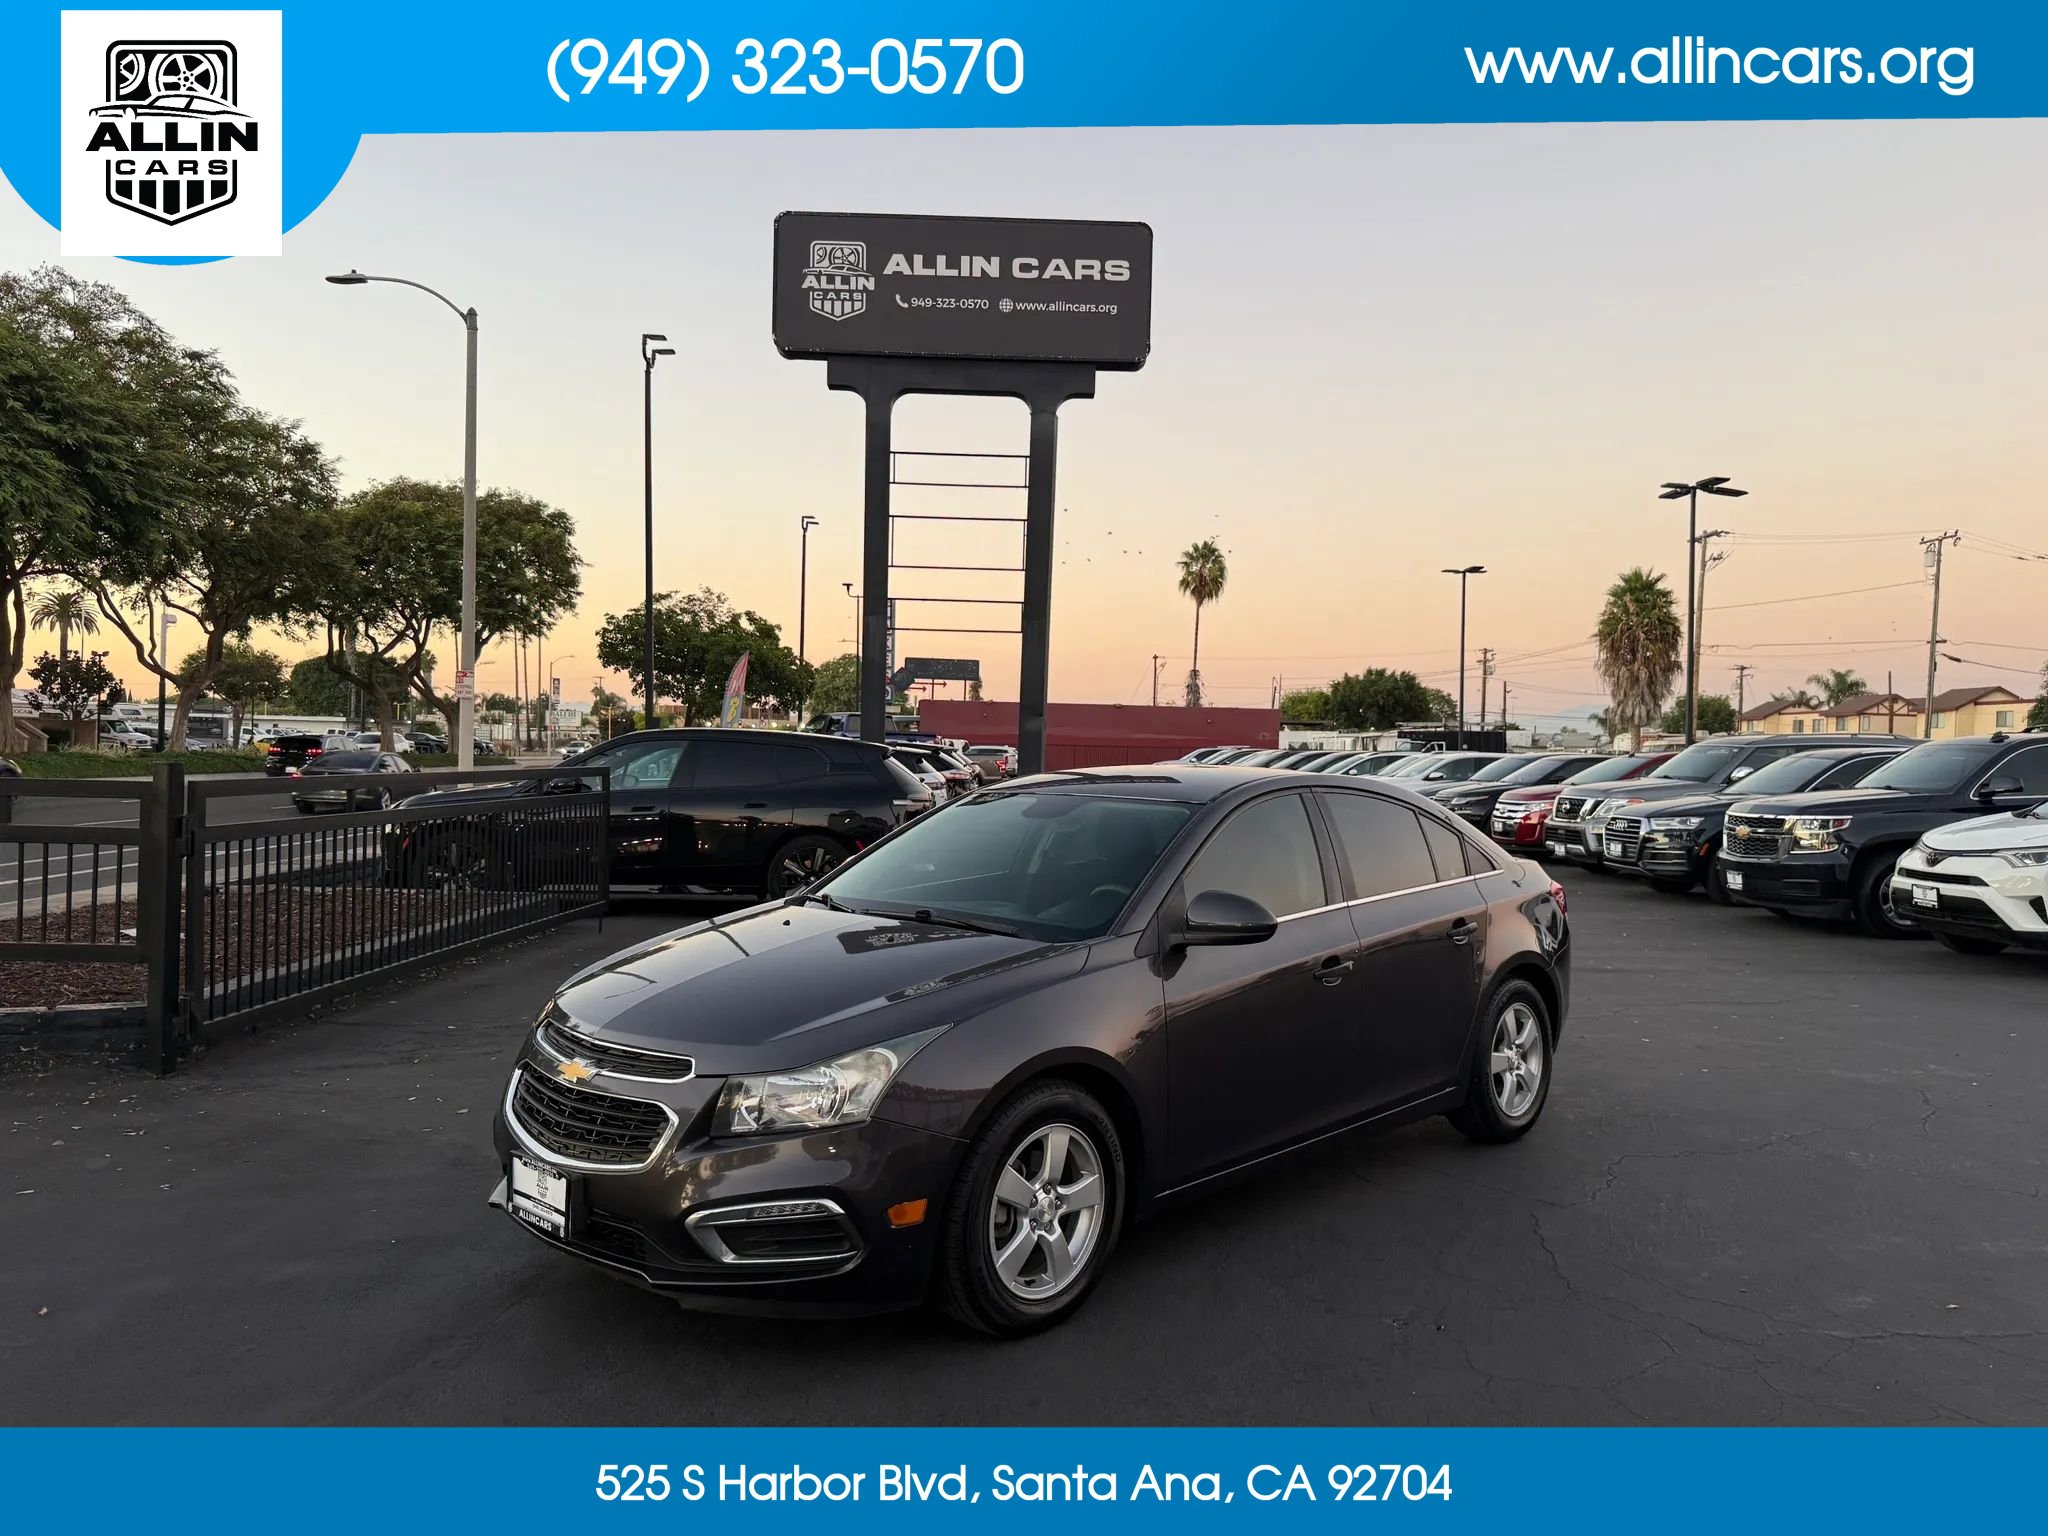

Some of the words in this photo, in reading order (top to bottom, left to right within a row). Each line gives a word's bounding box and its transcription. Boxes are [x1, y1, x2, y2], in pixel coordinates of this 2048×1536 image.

[883, 253, 1000, 278] ALLIN
[1012, 258, 1131, 282] CARS
[802, 273, 875, 291] ALLIN
[813, 291, 862, 301] CARS
[911, 297, 989, 310] 949-323-0570
[1015, 300, 1118, 315] www.allincars.org
[519, 1209, 552, 1231] ALLINCARS
